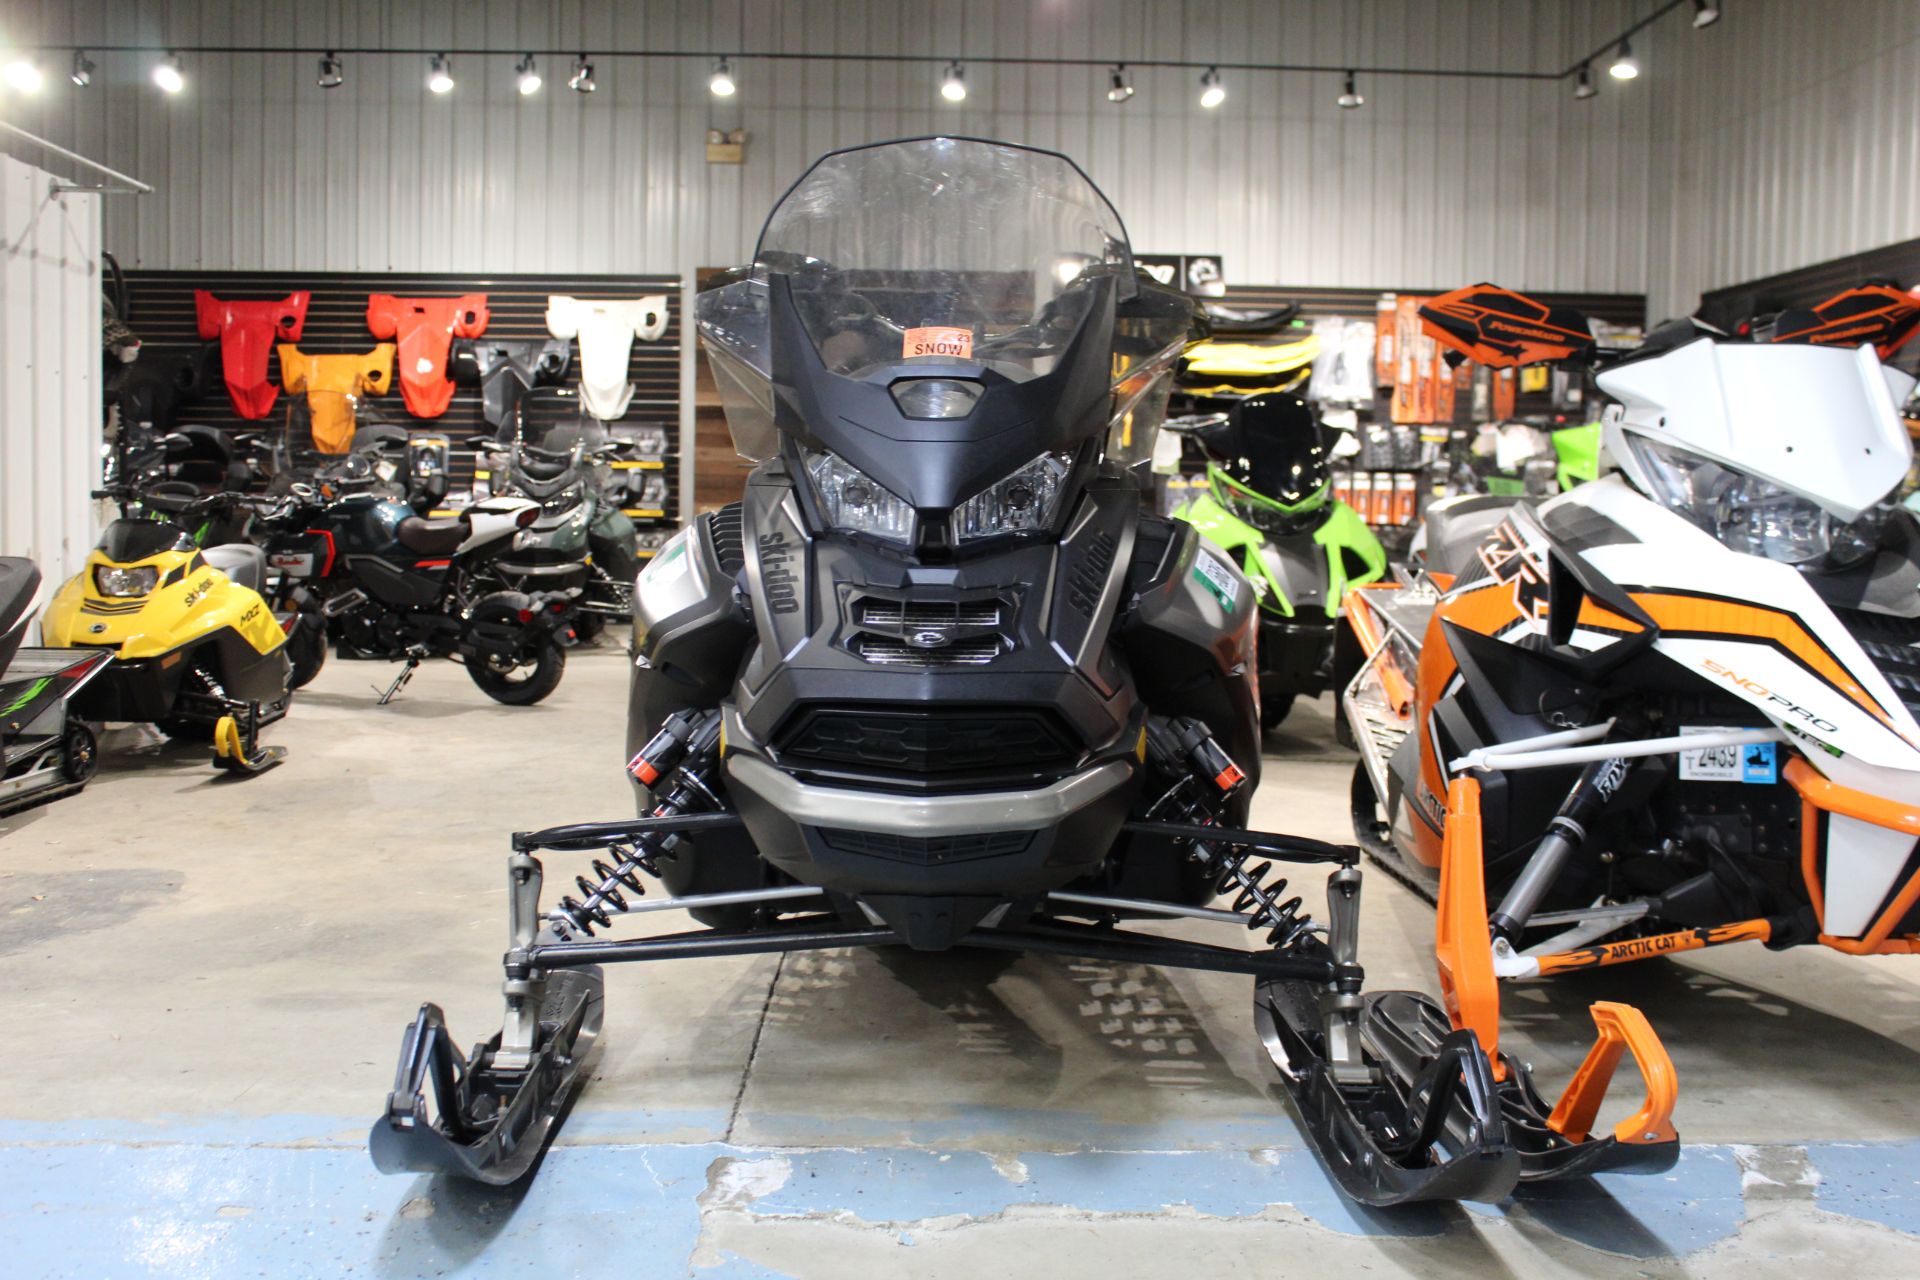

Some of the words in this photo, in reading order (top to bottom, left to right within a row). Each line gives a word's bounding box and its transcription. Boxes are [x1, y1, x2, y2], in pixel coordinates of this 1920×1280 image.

[914, 342, 963, 356] SNOW
[957, 333, 970, 343] 23
[759, 531, 800, 615] ski-doo
[239, 603, 262, 627] MXZ
[1698, 744, 1737, 768] 2439
[1611, 940, 1653, 960] ARCTIC
[1655, 935, 1676, 951] CAT
